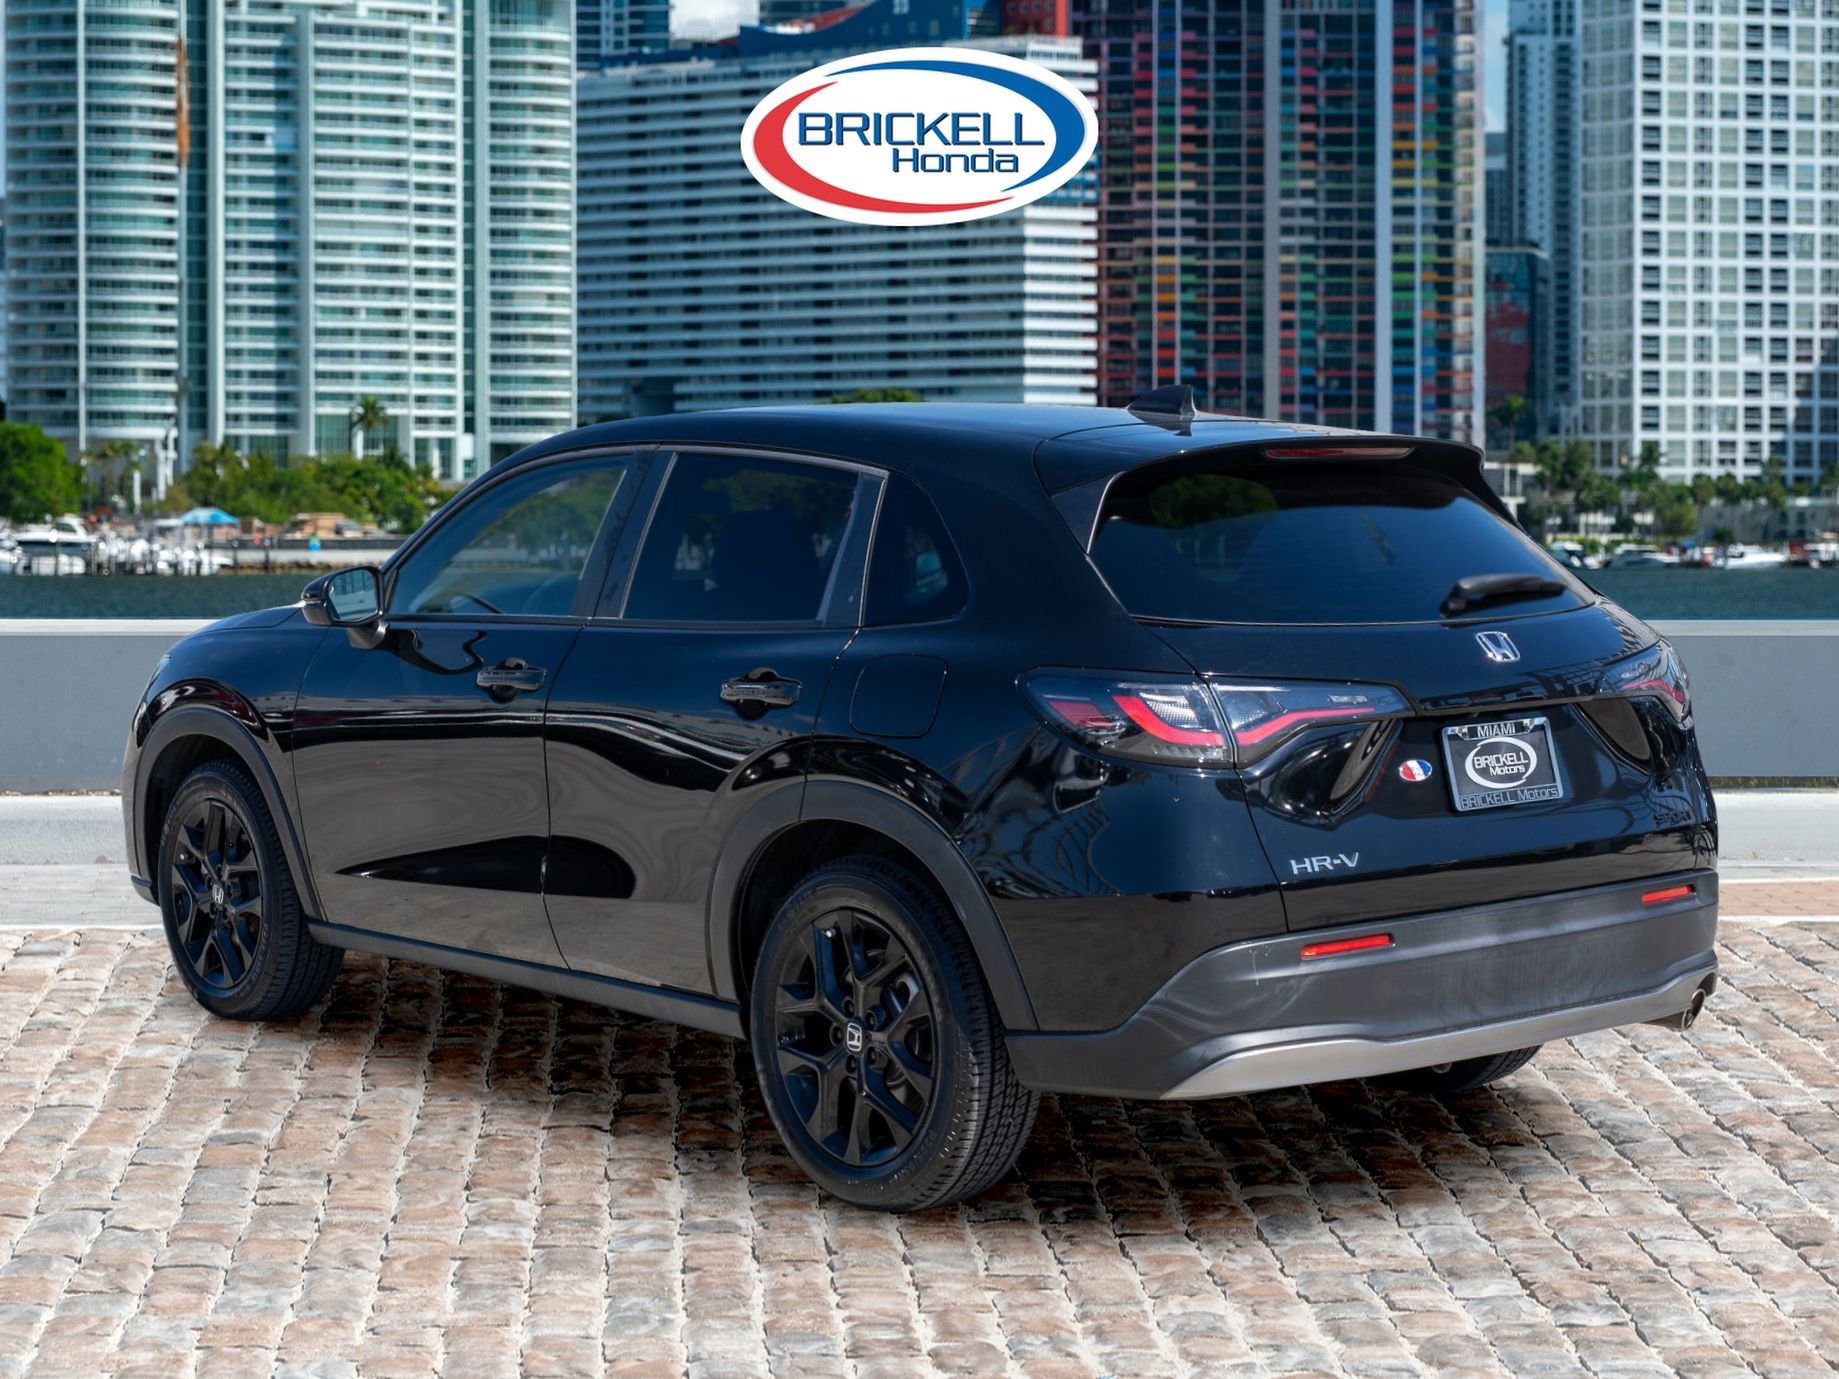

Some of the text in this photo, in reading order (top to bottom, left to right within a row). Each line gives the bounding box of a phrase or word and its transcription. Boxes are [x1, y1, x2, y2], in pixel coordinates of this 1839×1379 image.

[1477, 722, 1516, 738] MIAMI
[1474, 752, 1529, 769] BRICKELL
[1489, 764, 1526, 776] Motors
[1461, 787, 1558, 809] BRICKELL Motors
[1289, 852, 1359, 875] HR-V
